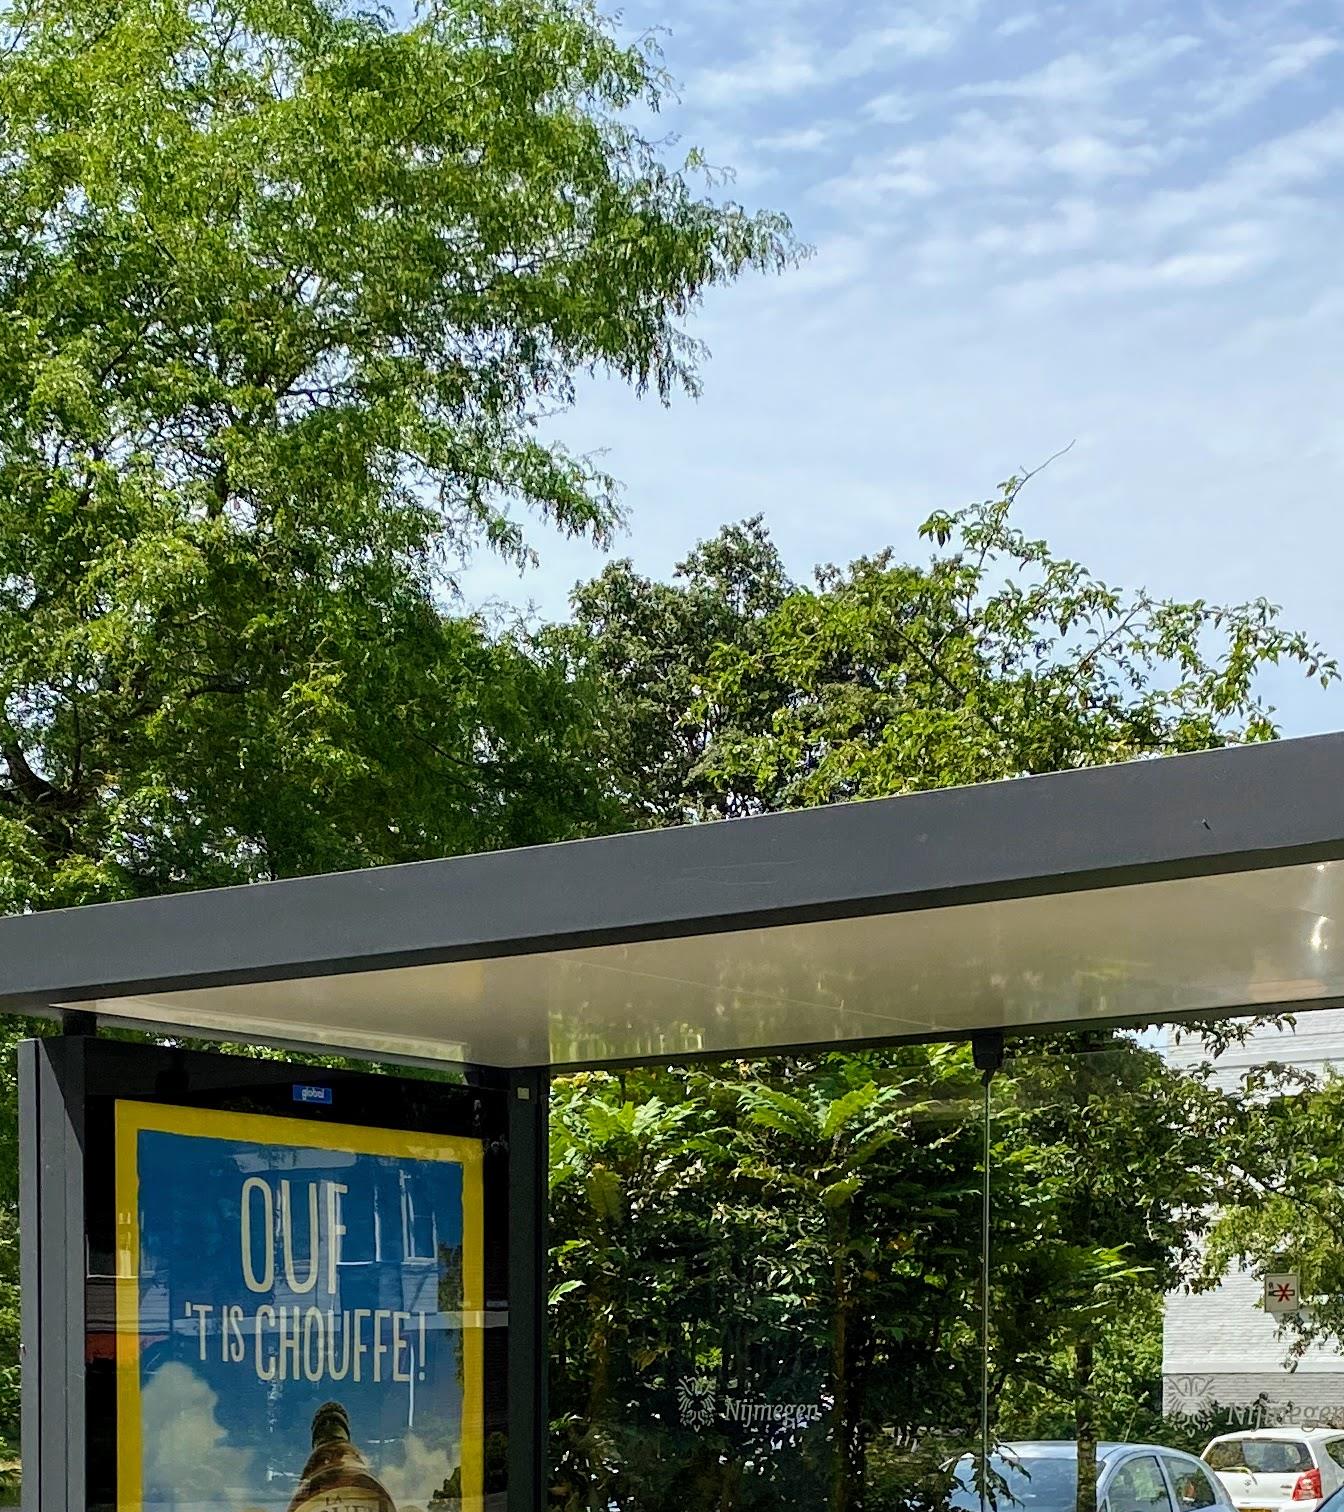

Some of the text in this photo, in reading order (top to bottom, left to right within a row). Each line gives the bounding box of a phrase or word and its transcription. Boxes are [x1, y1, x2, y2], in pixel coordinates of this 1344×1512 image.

[301, 1086, 324, 1101] global
[240, 1176, 348, 1295] OUF
[184, 1301, 213, 1361] 'T
[221, 1304, 245, 1363] IS
[724, 1400, 819, 1430] Nijmegen
[325, 1495, 344, 1506] LA
